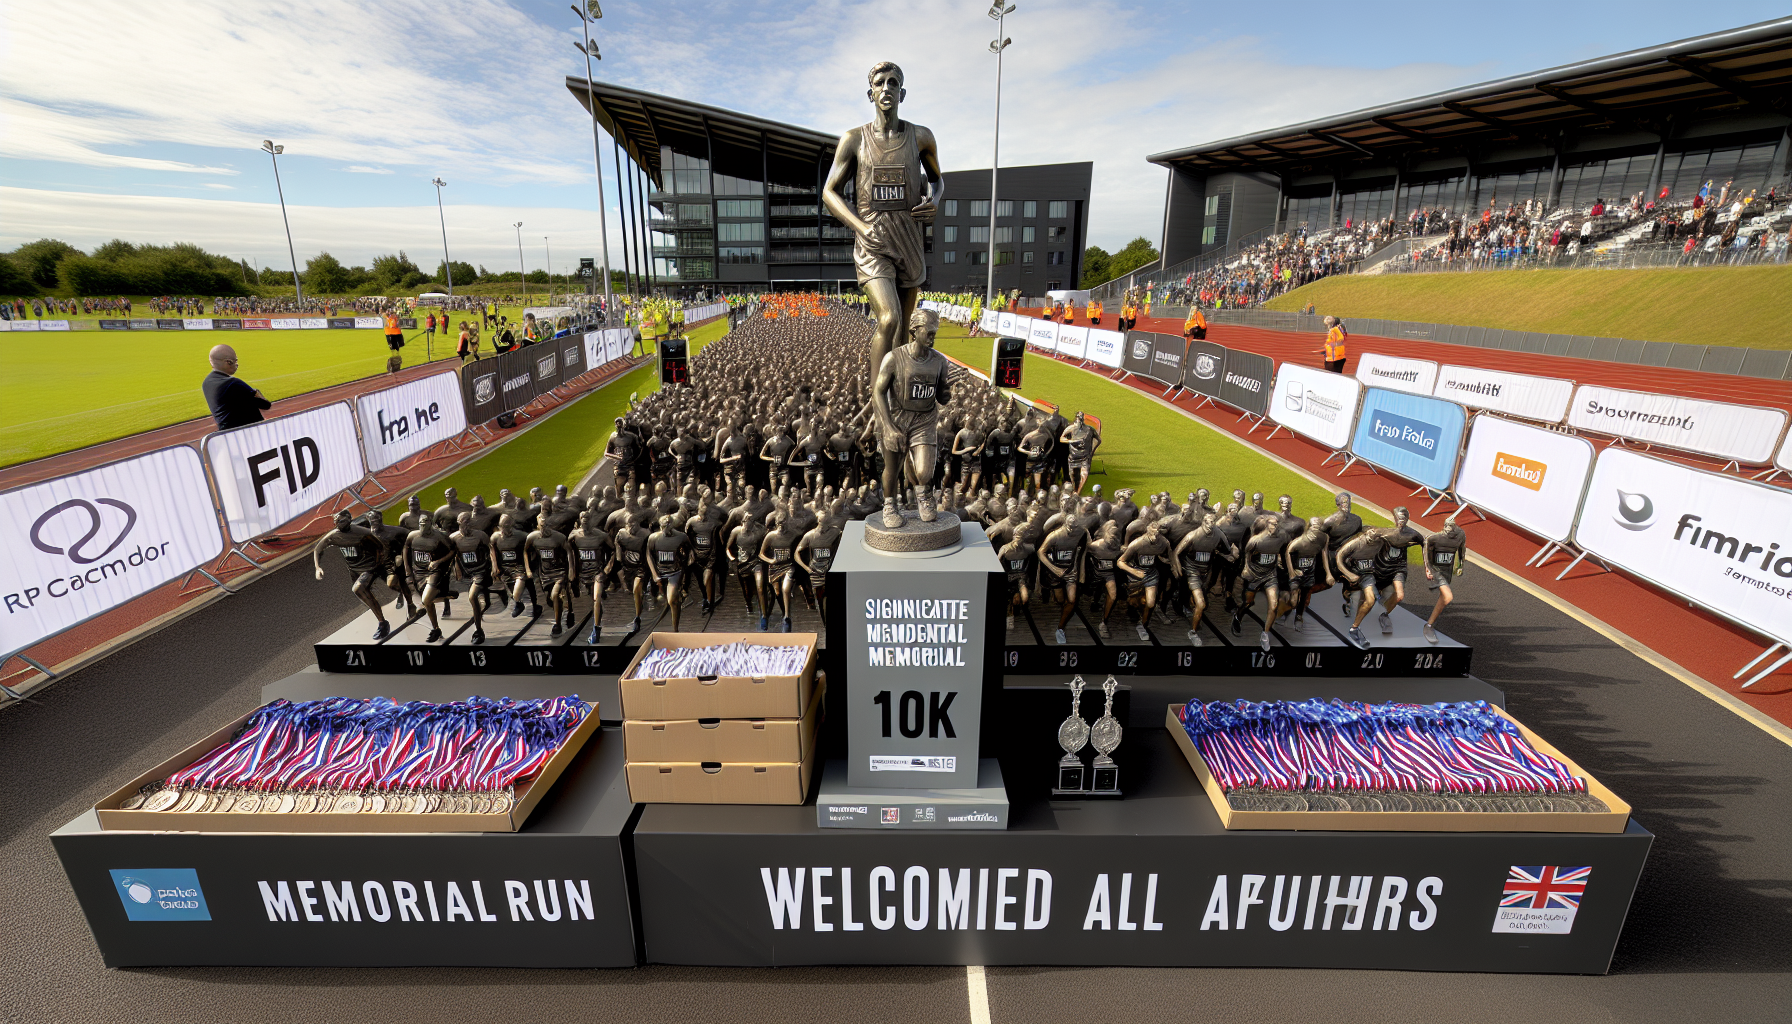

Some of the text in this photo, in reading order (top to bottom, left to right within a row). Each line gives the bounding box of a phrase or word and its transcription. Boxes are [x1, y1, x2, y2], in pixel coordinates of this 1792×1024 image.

[246, 436, 321, 509] FID
[3, 586, 41, 614] RP
[468, 650, 487, 667] 13
[582, 650, 600, 667] 12
[873, 690, 959, 739] 10K
[257, 879, 596, 922] MEMORIAL RUN
[760, 865, 1053, 932] WELCOMIED
[1082, 872, 1164, 931] ALL
